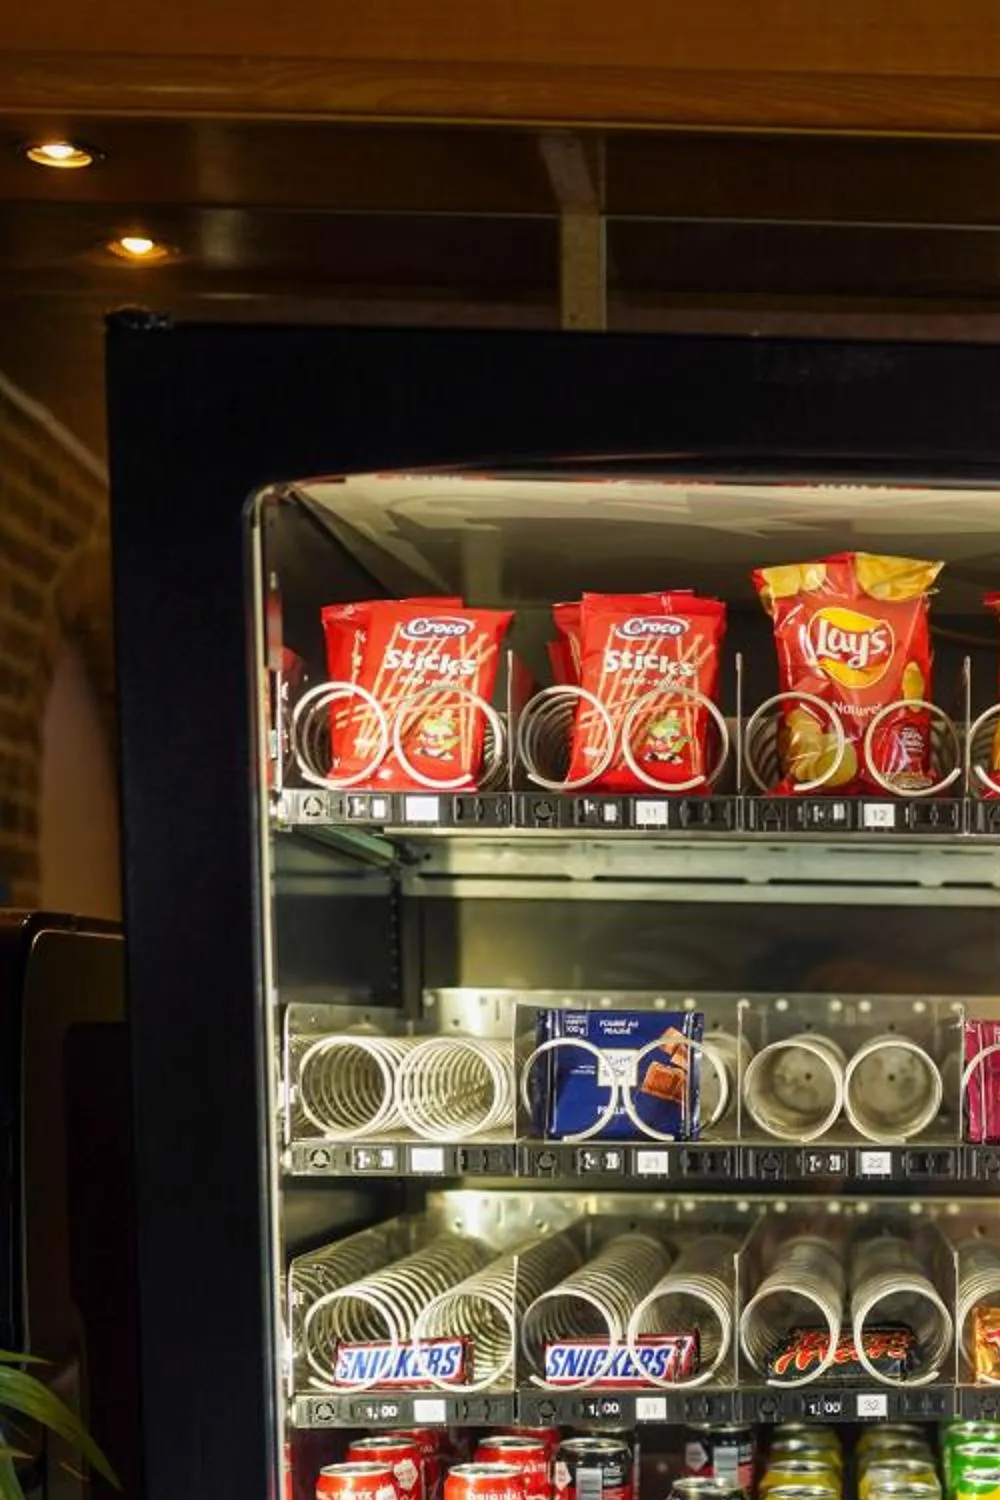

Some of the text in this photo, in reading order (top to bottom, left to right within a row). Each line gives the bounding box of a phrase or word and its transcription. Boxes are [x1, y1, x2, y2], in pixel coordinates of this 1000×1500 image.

[406, 617, 472, 636] Croco
[622, 617, 684, 636] Croco
[817, 617, 888, 669] Lay's
[383, 649, 477, 676] Sticks
[604, 649, 696, 677] Sticks
[546, 1347, 671, 1377] SNICKERS
